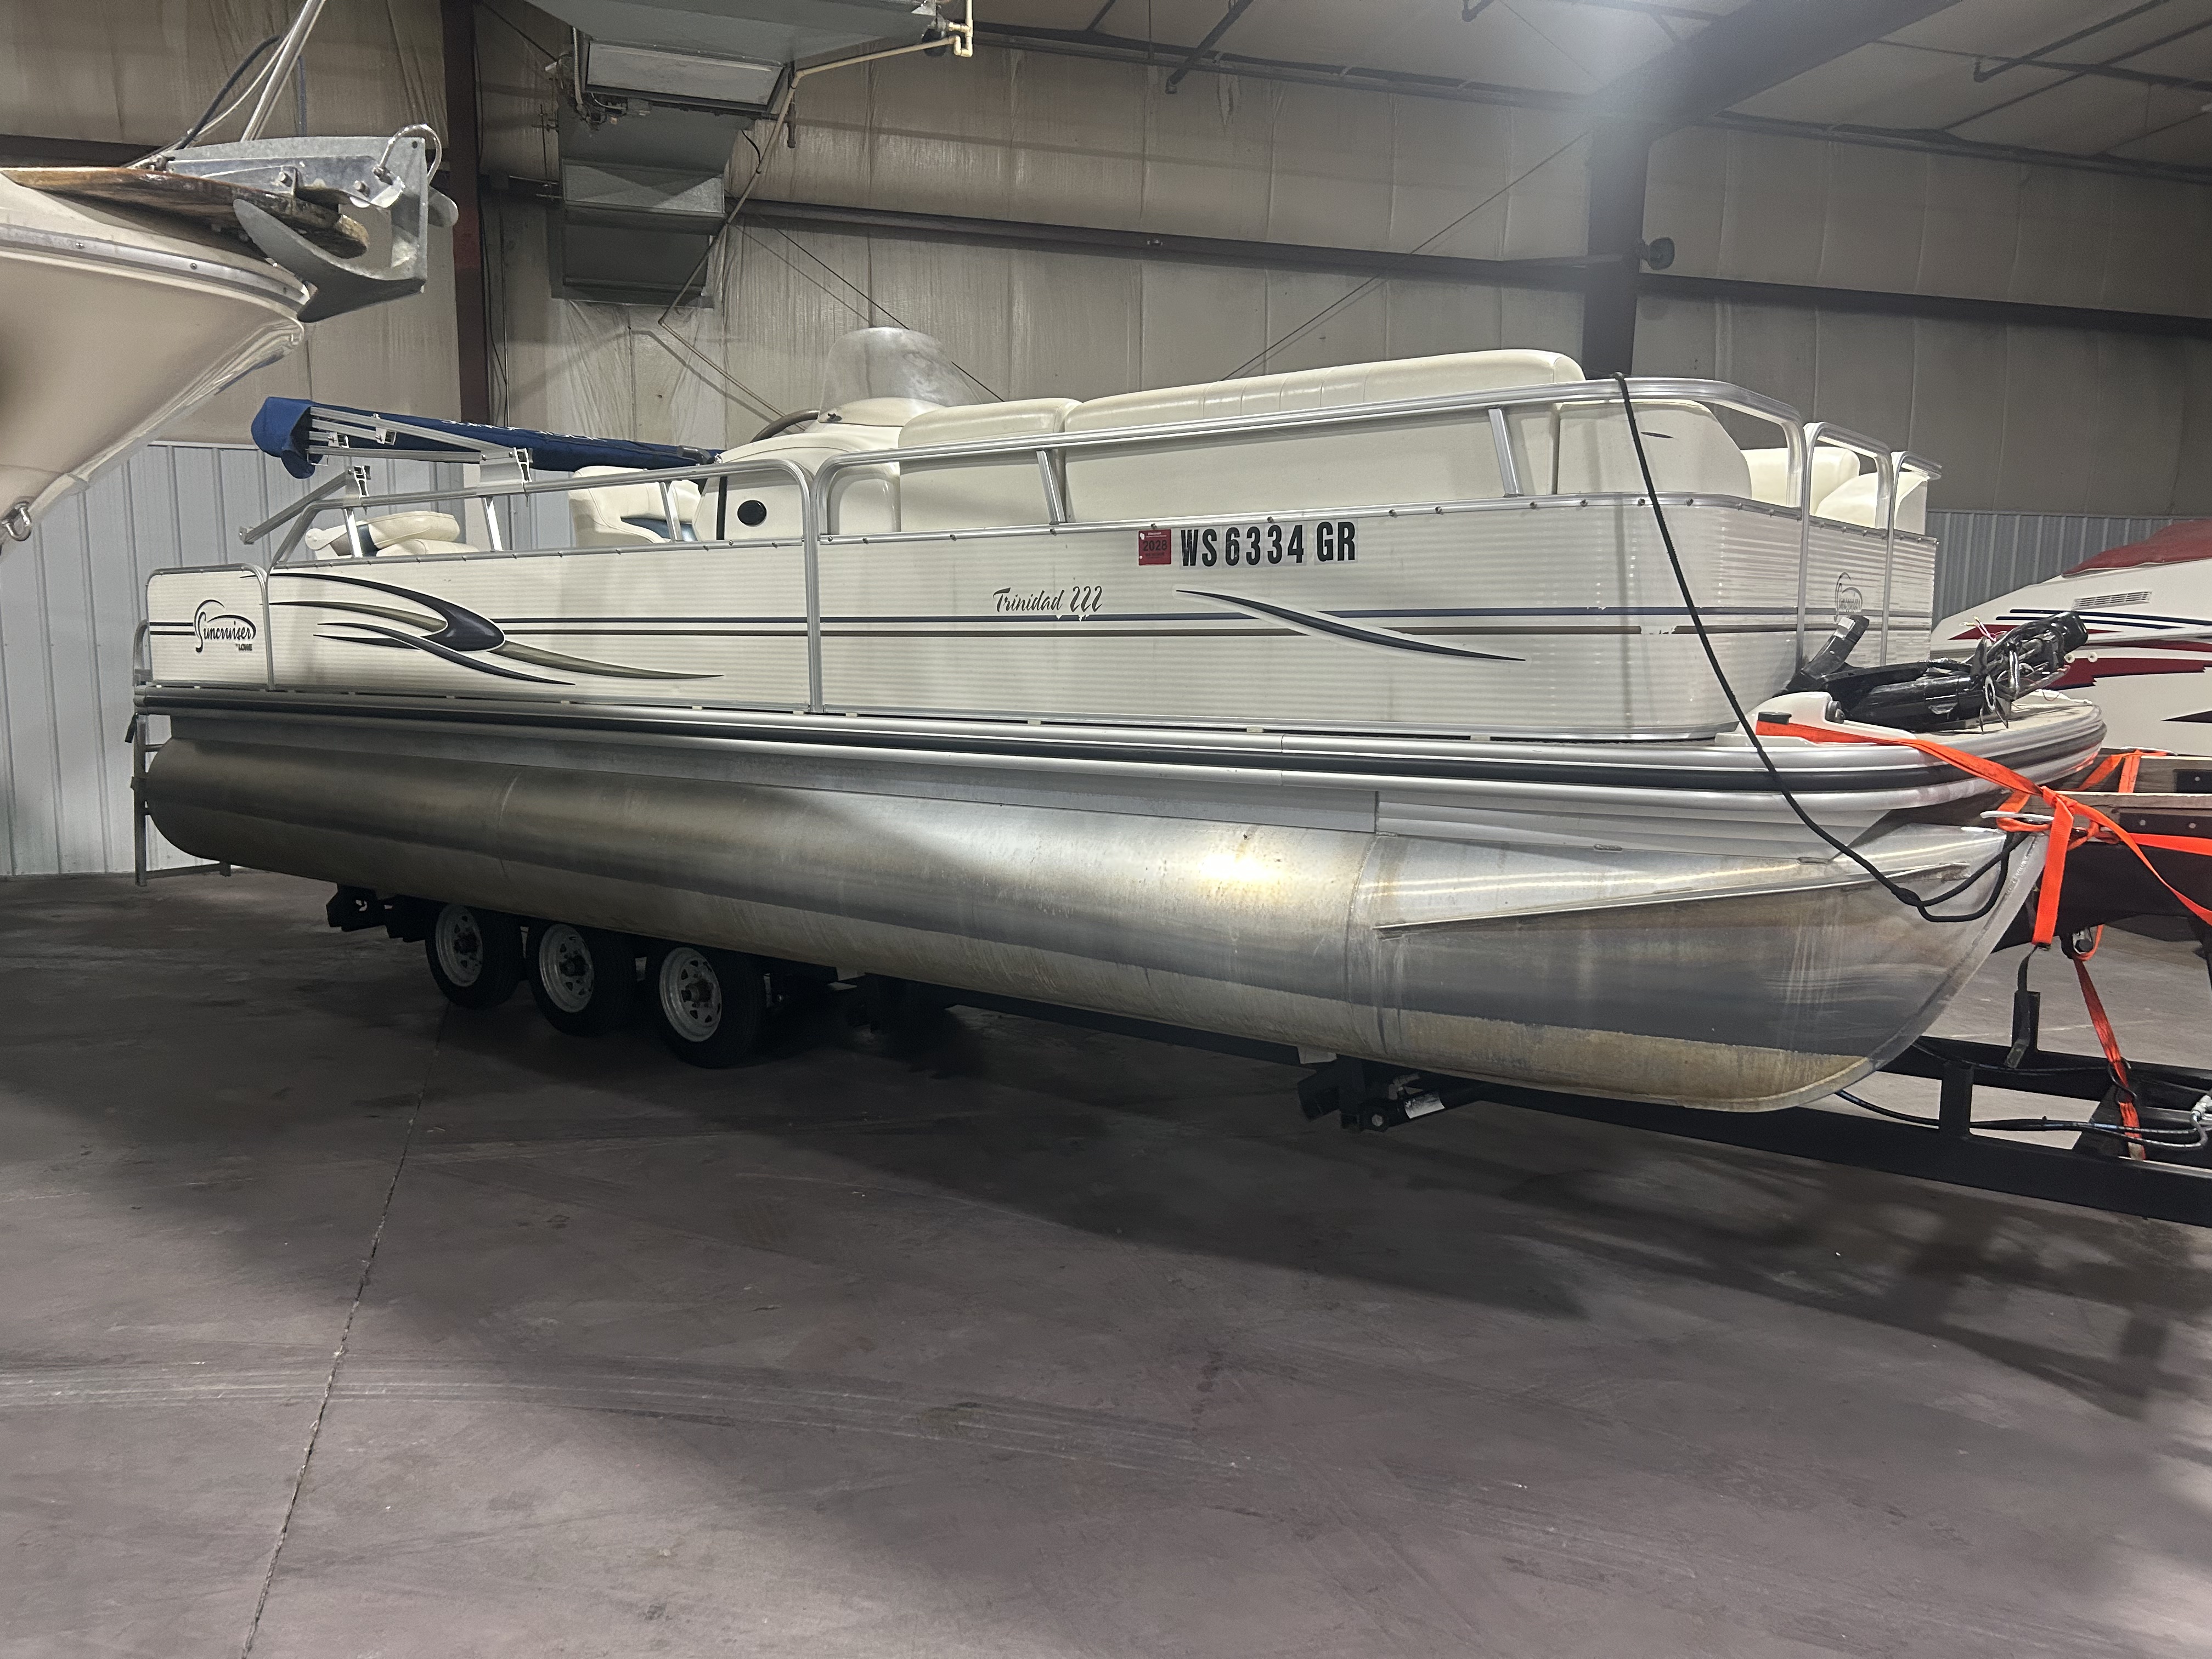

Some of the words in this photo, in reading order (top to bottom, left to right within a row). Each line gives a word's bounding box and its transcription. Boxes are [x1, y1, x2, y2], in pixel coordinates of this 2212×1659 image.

[1143, 540, 1167, 551] 2028
[1181, 528, 1217, 567] WS
[1225, 524, 1304, 566] 6334
[1317, 521, 1356, 562] GR
[993, 587, 1065, 612] Trinidad
[1070, 585, 1103, 613] 222
[195, 610, 252, 653] Suncruiser
